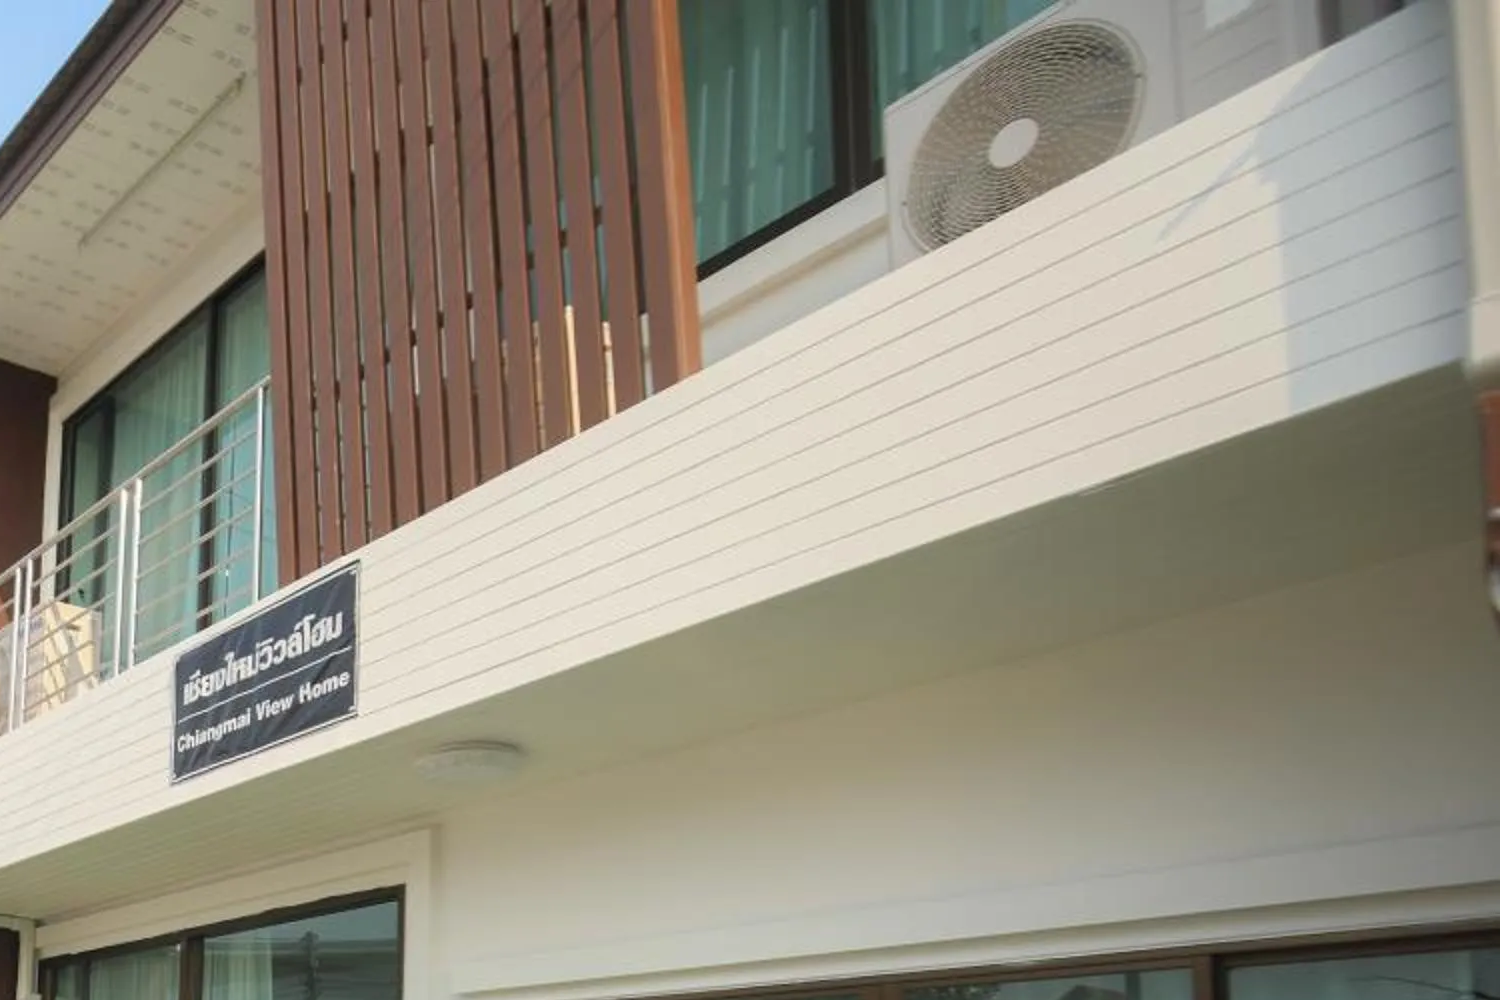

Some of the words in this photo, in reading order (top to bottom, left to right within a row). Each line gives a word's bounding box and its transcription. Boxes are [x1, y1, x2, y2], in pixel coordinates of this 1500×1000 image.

[177, 707, 250, 753] Chiangmai
[255, 694, 295, 721] View
[299, 671, 350, 703] Home
